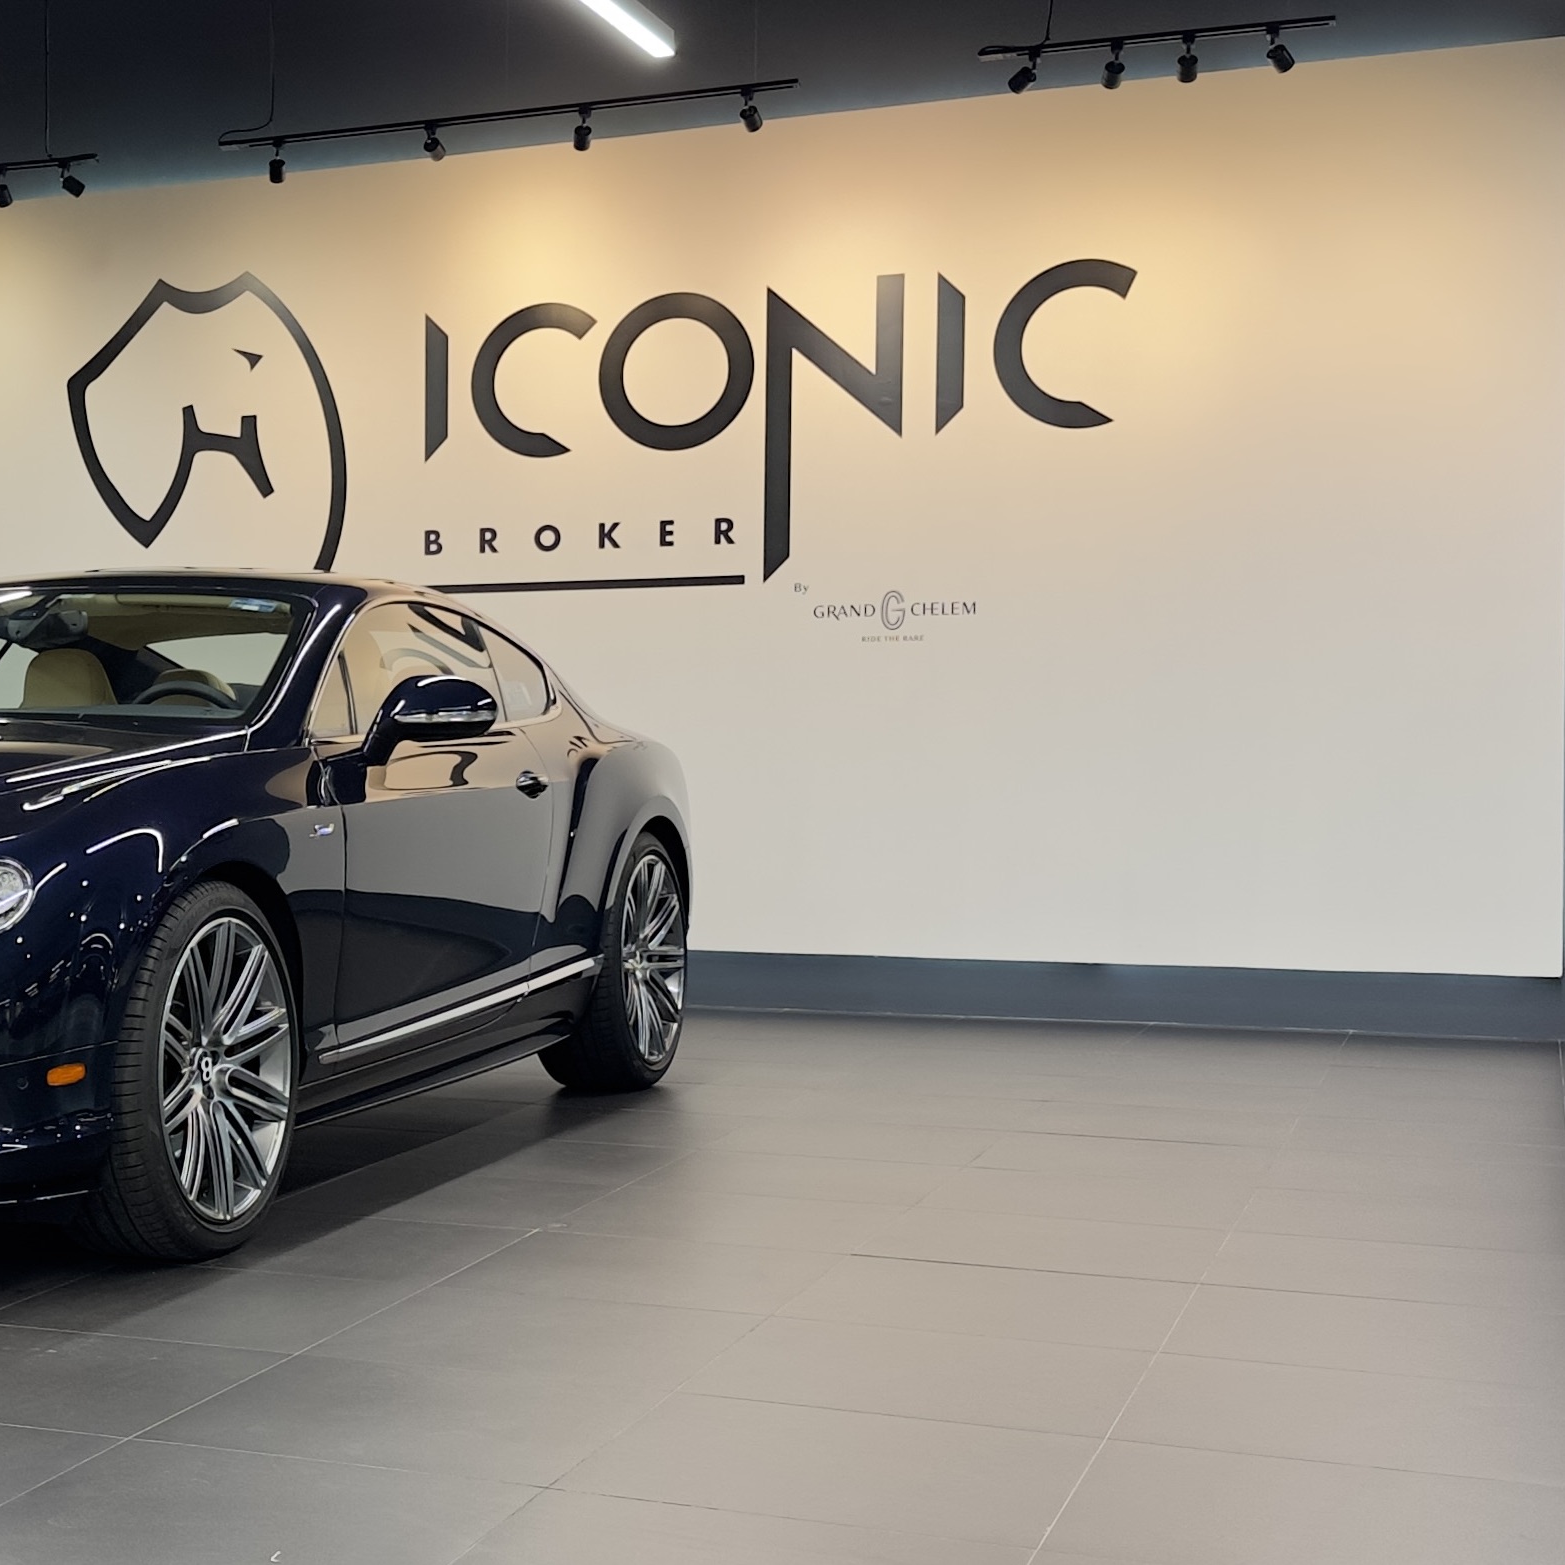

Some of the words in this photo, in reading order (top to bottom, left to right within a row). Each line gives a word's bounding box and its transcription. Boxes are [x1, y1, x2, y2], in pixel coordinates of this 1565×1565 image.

[424, 258, 1138, 584] ICONIC
[424, 517, 736, 556] BROKER
[793, 582, 810, 596] By
[813, 603, 876, 621] GRAND
[910, 601, 977, 616] CHELEM
